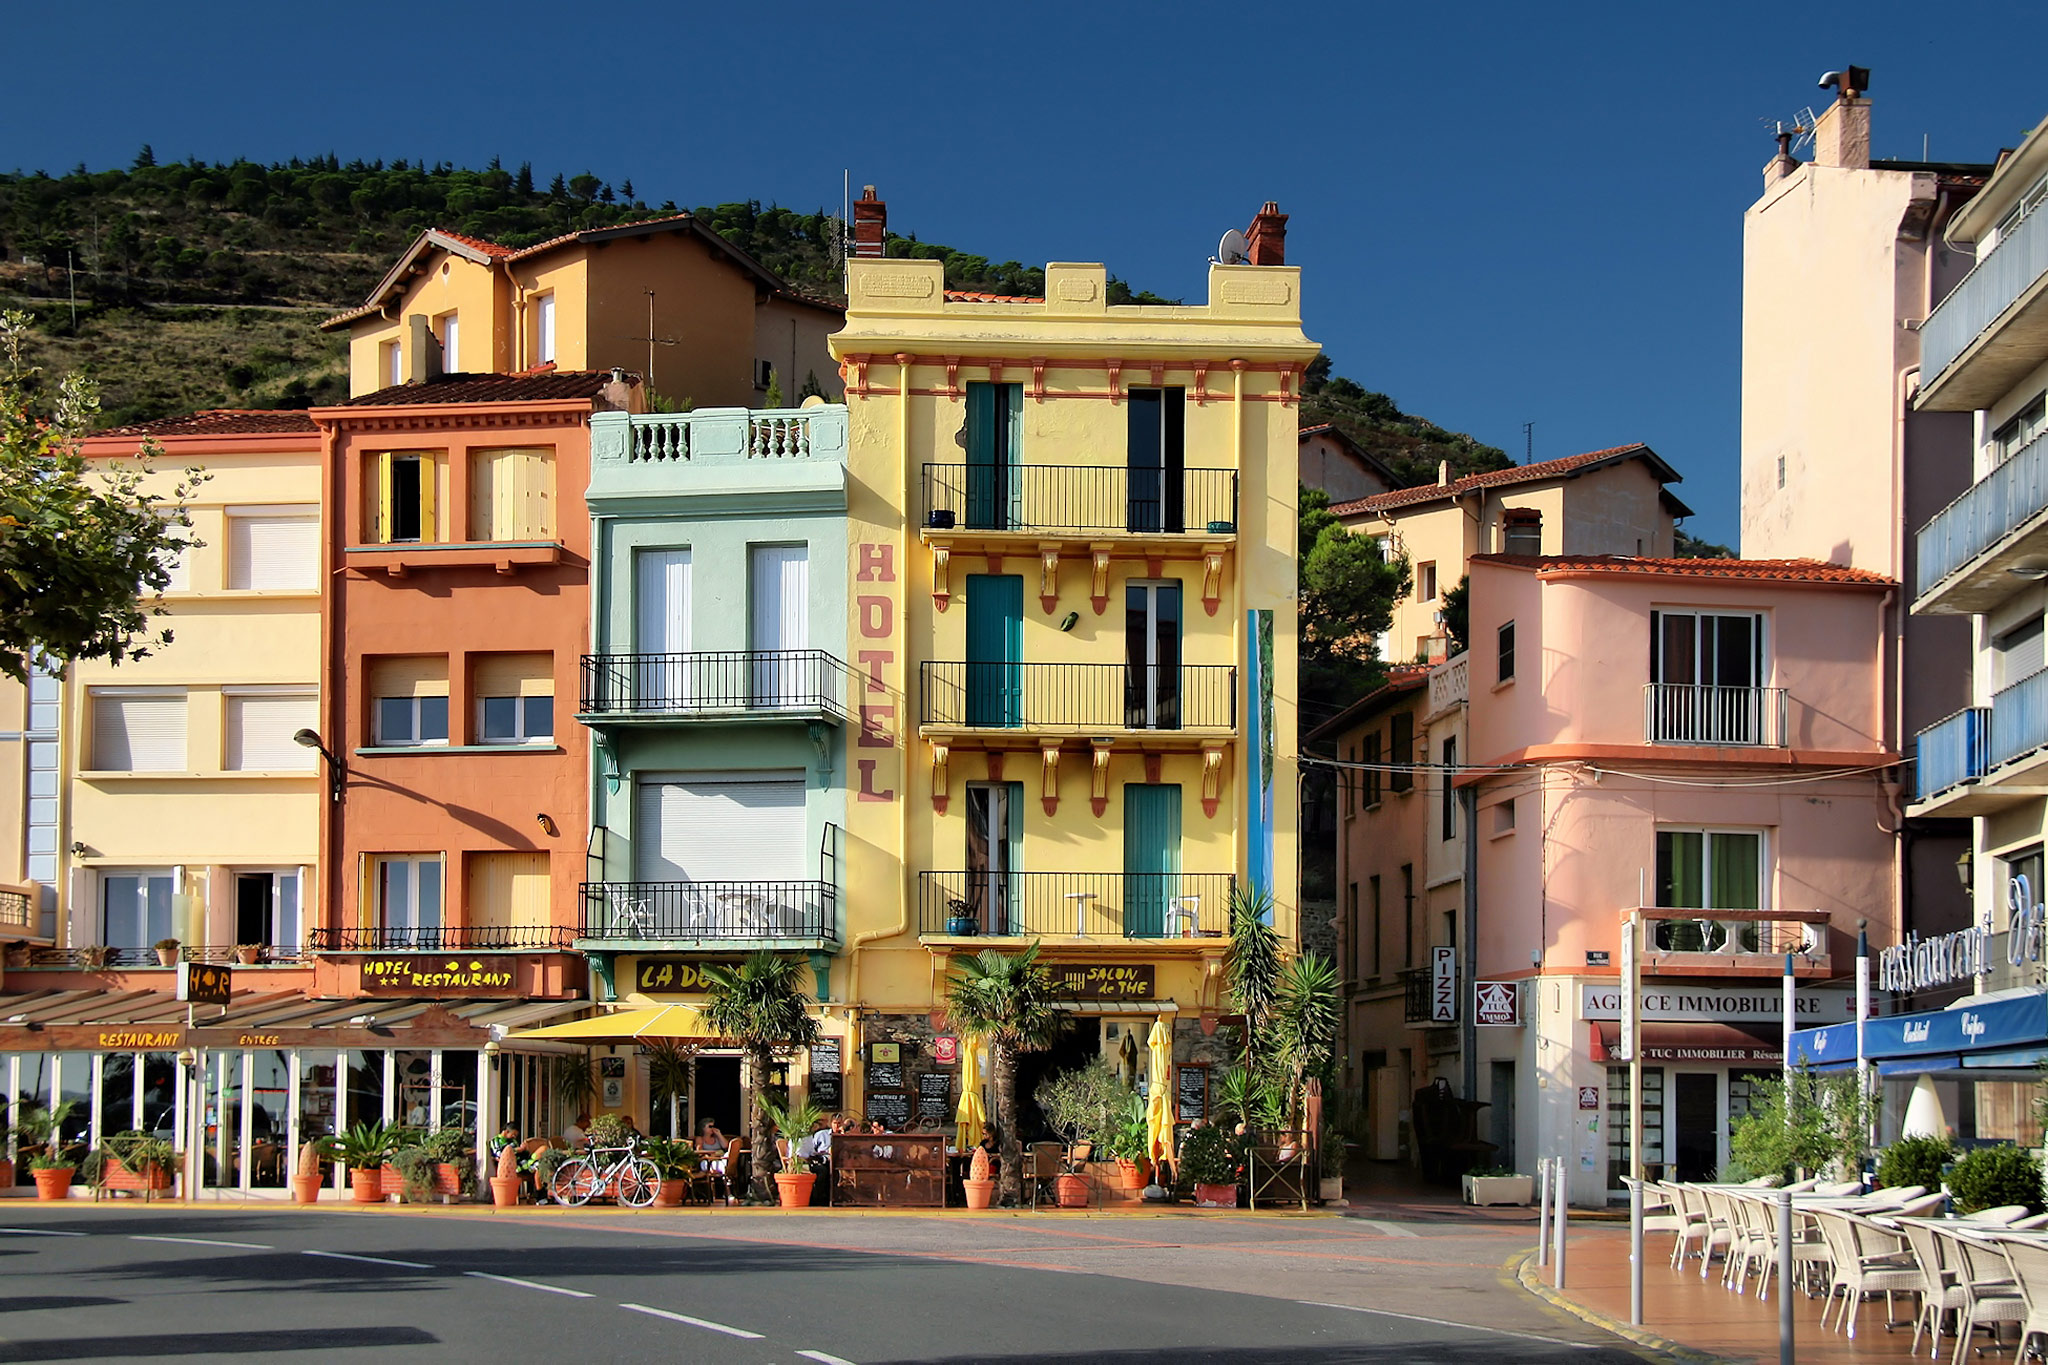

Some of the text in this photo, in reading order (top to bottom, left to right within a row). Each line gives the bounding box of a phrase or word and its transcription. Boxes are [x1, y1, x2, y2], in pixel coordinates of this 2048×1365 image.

[857, 543, 896, 802] HOTEL
[1879, 910, 1993, 992] restaurant
[364, 961, 412, 976] HOTEL
[1087, 967, 1138, 981] SALON
[411, 972, 511, 987] RESTAURANT
[641, 964, 673, 988] LA
[1099, 981, 1148, 994] de THE
[1436, 949, 1452, 1018] PIZZA
[1487, 1003, 1508, 1011] TUC
[1587, 994, 1820, 1013] AGCE IMMOBILIRE
[1483, 1013, 1506, 1021] IMMO
[99, 1033, 180, 1047] RESTAURANT
[239, 1035, 280, 1046] ENTREE
[1650, 1048, 1672, 1058] TUC
[1677, 1048, 1746, 1059] IMMOBILIER
